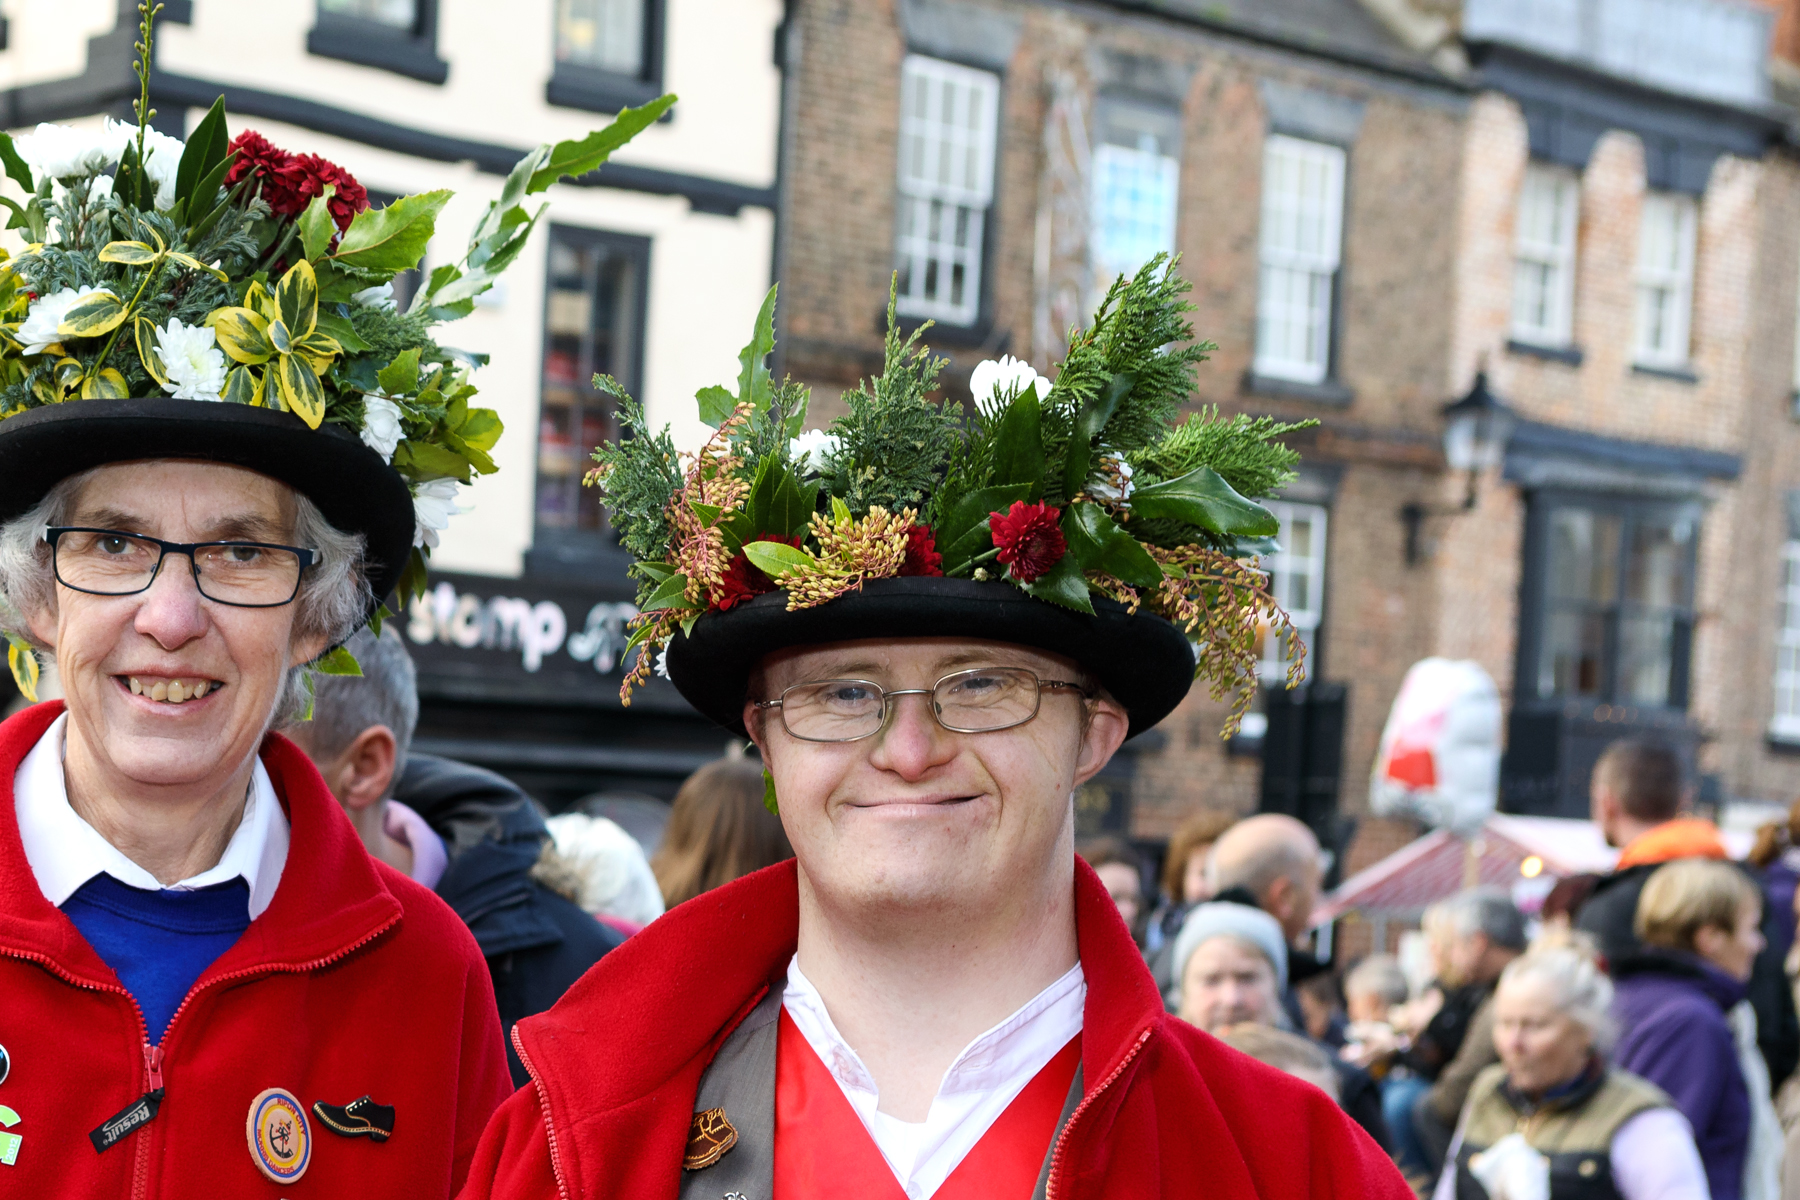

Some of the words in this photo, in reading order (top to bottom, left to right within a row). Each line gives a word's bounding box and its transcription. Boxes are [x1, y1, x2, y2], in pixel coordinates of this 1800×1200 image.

[277, 1098, 296, 1115] RIPON
[295, 1113, 306, 1135] CITY
[5, 1137, 19, 1161] 2012
